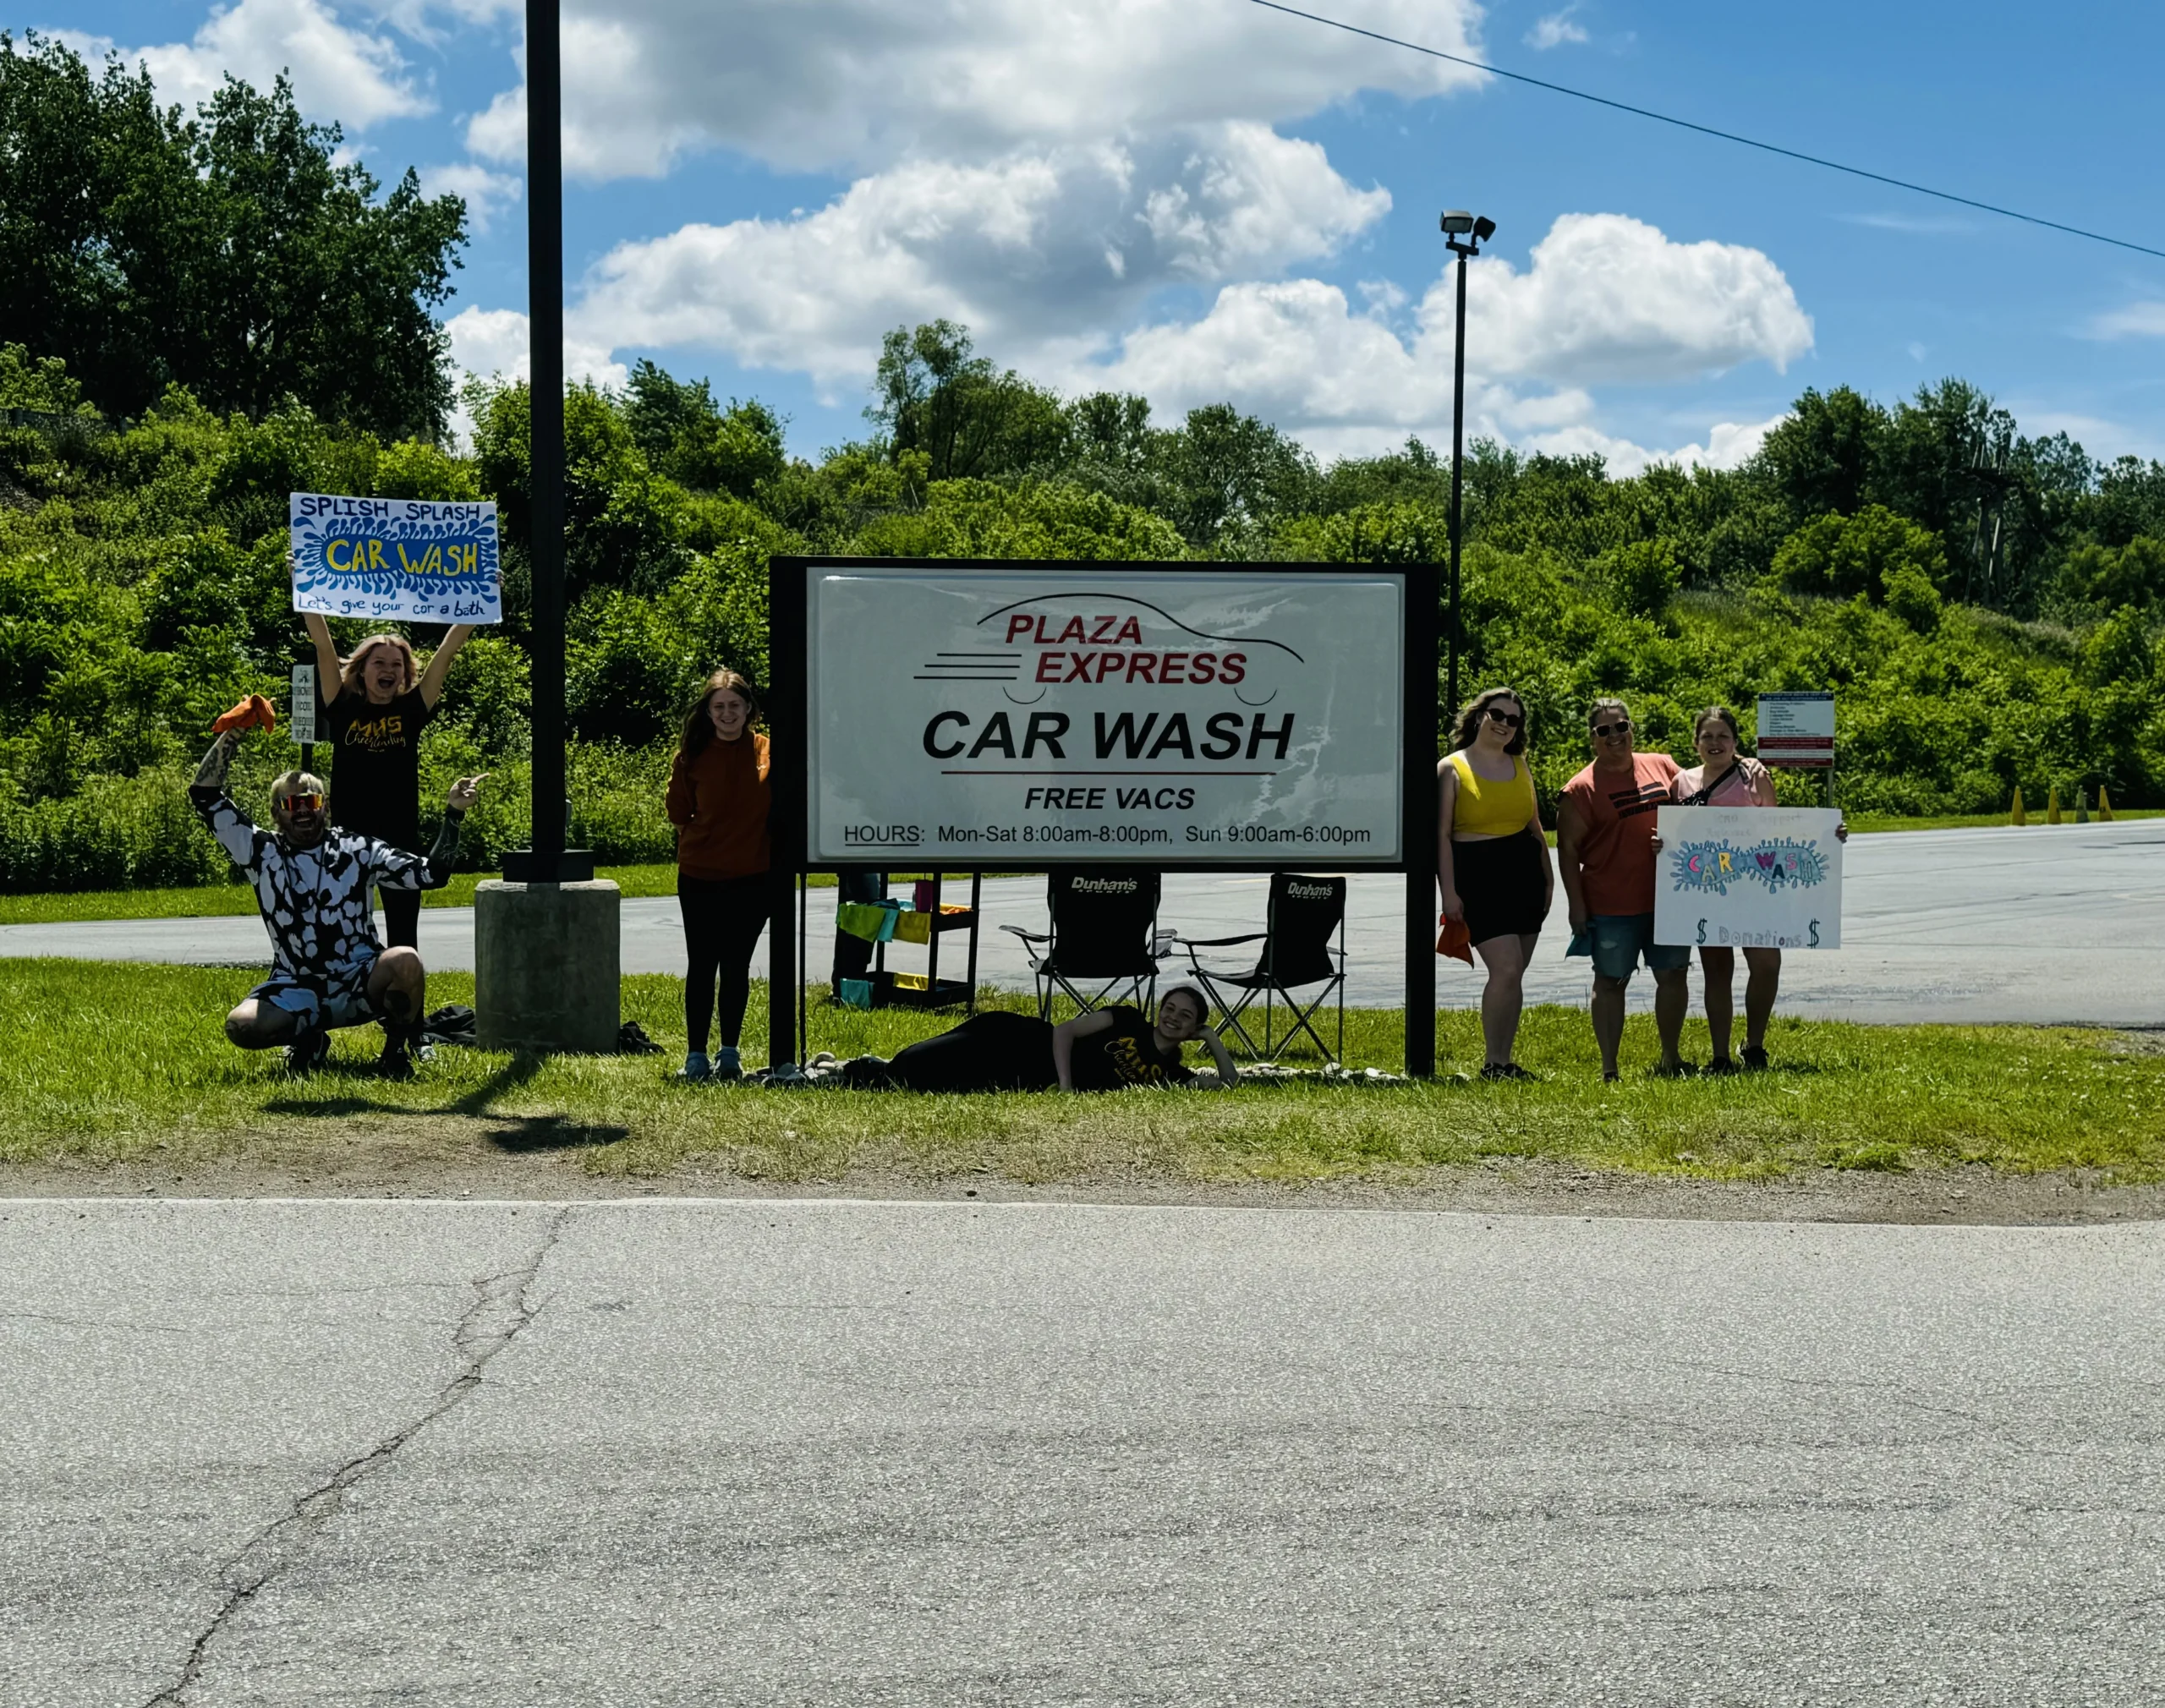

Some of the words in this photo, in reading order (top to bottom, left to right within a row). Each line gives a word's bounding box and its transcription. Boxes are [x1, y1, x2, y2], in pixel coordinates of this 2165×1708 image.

[299, 496, 388, 517] SPLISH
[405, 502, 480, 521] SPLASH
[326, 539, 391, 572] CAR
[397, 542, 478, 577] WASH
[298, 594, 332, 610] Let's
[342, 599, 365, 615] give
[372, 601, 404, 616] your
[440, 605, 450, 615] a
[454, 600, 485, 616] bath
[1006, 616, 1142, 643] PLAZA
[1035, 653, 1247, 684] EXPRESS
[923, 710, 1071, 760] CAR
[1093, 711, 1296, 760] WASH
[1024, 787, 1107, 810] FREE
[1115, 787, 1196, 810] VACS
[844, 825, 925, 844] HOURS:
[938, 825, 1017, 842] Mon-Sat
[1022, 825, 1174, 846] 8:00am-8:00pm,
[1186, 825, 1221, 842] Sun
[1227, 825, 1371, 846] 9:00am-6:00pm
[1688, 851, 1733, 883] CAR
[1755, 852, 1813, 880] WASH
[1071, 876, 1137, 890] Dunham's
[1287, 882, 1333, 896] Dunham's
[1718, 925, 1802, 949] Donations
